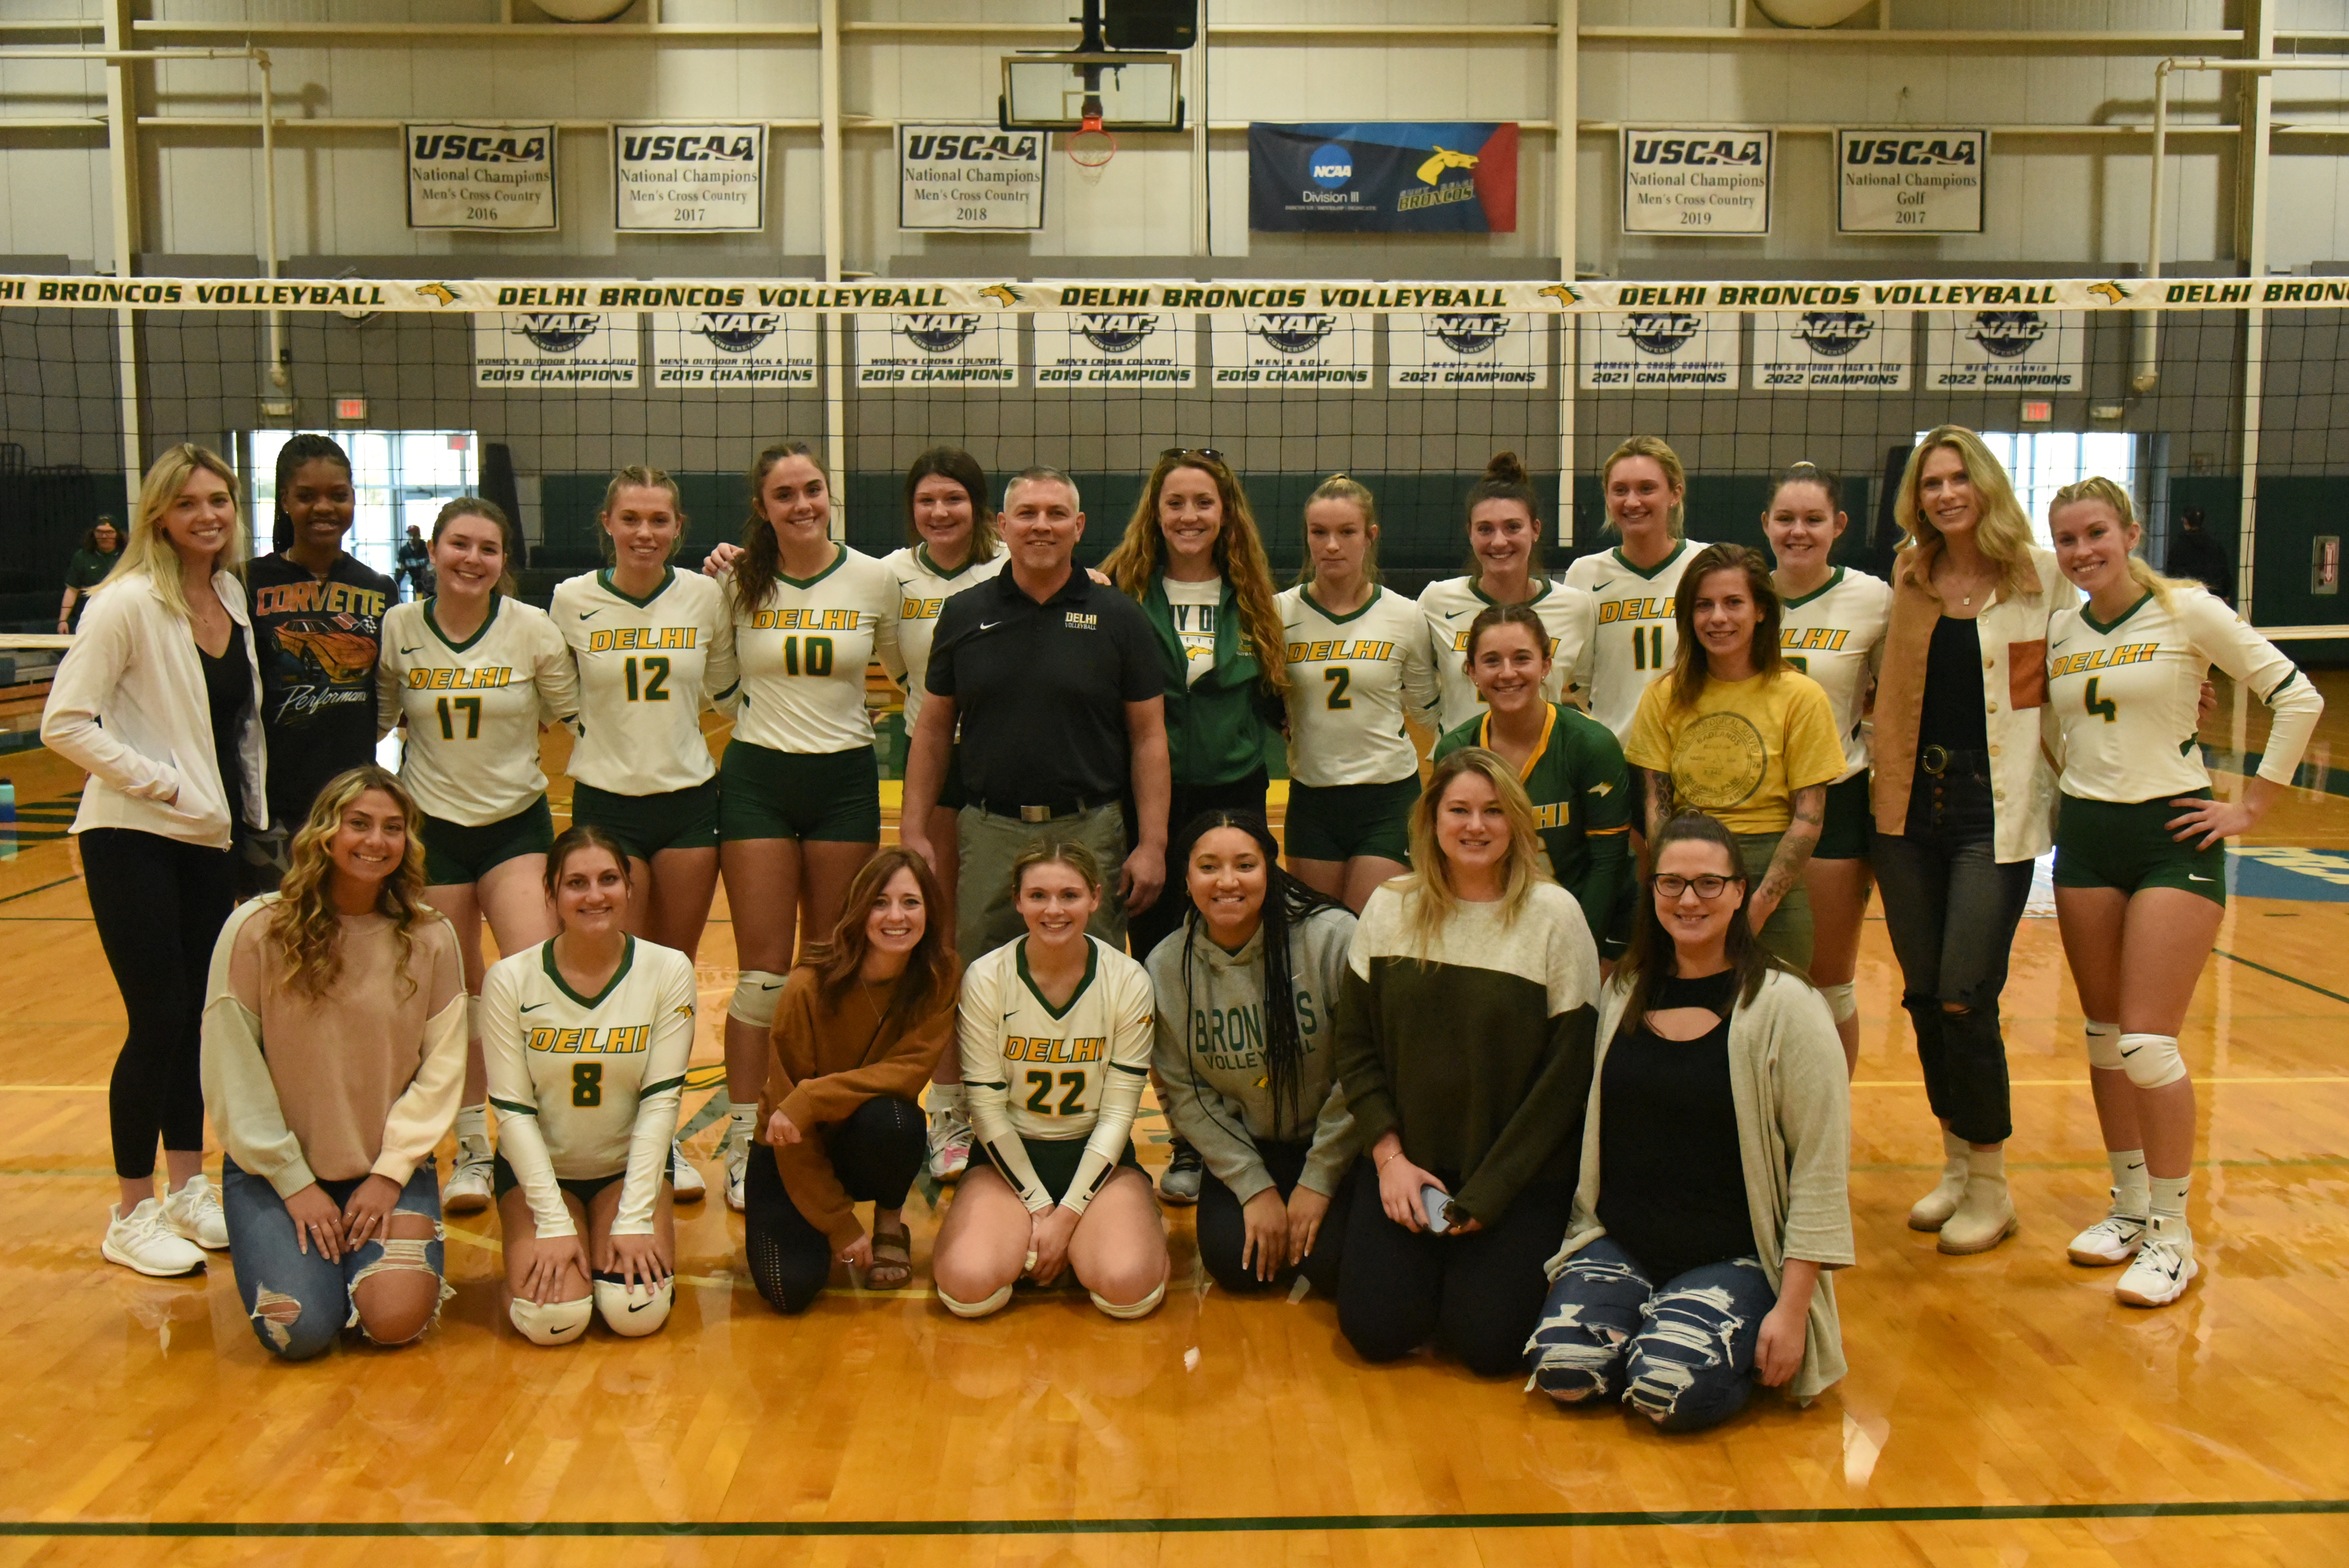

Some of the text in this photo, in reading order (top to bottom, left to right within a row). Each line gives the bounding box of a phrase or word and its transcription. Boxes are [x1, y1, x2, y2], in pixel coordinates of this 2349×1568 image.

[415, 135, 545, 163] USCAA
[624, 135, 754, 162] USCAA
[908, 135, 1037, 160] USCAA
[1633, 140, 1762, 166] USCAA
[1846, 140, 1975, 166] USCAA
[412, 168, 550, 187] National Champions
[620, 168, 758, 186] National Champions
[905, 168, 1040, 185] National Champions
[1313, 165, 1352, 178] NCAA
[1629, 172, 1765, 190] National Champions
[1846, 173, 1977, 190] National Champions
[423, 188, 542, 204] Men's Cross Country
[630, 189, 747, 205] Men's Cross Country
[914, 188, 1030, 204] Men's Cross Country
[1302, 190, 1359, 203] Division III
[1397, 185, 1474, 212] BRONCOS
[1637, 193, 1755, 208] Men's Cross Country
[1897, 191, 1926, 206] Golf
[466, 207, 498, 221] 2016
[674, 208, 705, 222] 2017
[956, 208, 988, 220] 2018
[1680, 212, 1712, 225] 2019
[1895, 211, 1926, 225] 2017
[38, 282, 183, 304] BRONCOS
[196, 284, 386, 305] VOLLEYBALL
[498, 286, 950, 307] DELHI BRONCOS VOLLEYBALL
[1059, 287, 1510, 308] DELHI BRONCOS VOLLEYBALL
[1617, 285, 2059, 306] DELHI BRONCOS VOLLEYBALL
[2165, 283, 2349, 303] DELHI BRON
[511, 313, 601, 334] NAC
[691, 313, 780, 334] NAC
[892, 314, 981, 334] NAC
[1070, 314, 1159, 335] NAC
[1248, 315, 1337, 335] NAC
[1426, 317, 1510, 336] NAC
[1617, 318, 1701, 337] NAC
[1791, 320, 1874, 339] NAC
[1965, 321, 2048, 340] NAC
[481, 370, 633, 381] 2019 CHAMPIONS
[660, 370, 813, 381] 2019 CHAMPIONS
[861, 369, 1014, 381] 2019 CHAMPIONS
[1039, 370, 1191, 381] 2019 CHAMPIONS
[1216, 370, 1368, 382] 2019 CHAMPIONS
[1399, 372, 1536, 382] 2021 CHAMPIONS
[1592, 373, 1727, 383] 2021 CHAMPIONS
[1764, 374, 1898, 384] 2022 CHAMPIONS
[1938, 374, 2072, 385] 2022 CHAMPIONS
[256, 580, 386, 617] CORVETTE
[751, 609, 860, 631] DELHI
[1065, 611, 1097, 625] DELHI
[1598, 597, 1677, 625] DELH
[1065, 622, 1097, 630] VOLLEYBALL
[589, 626, 698, 653] DELHI
[1632, 624, 1664, 671] 11
[1780, 628, 1850, 651] LHI
[782, 635, 834, 677] 10
[1286, 640, 1395, 664] DELHI
[2049, 643, 2160, 681] DELHI
[407, 667, 512, 690] DELHI
[623, 654, 671, 702] 12
[1323, 666, 1352, 711] 2
[2084, 674, 2117, 724] 4
[435, 696, 482, 740] 17
[1697, 731, 1741, 746] BADLANDS
[1195, 990, 1317, 1052] BRONS
[528, 1024, 650, 1054] DELHI
[1004, 1035, 1106, 1063] DELHI
[1204, 1039, 1316, 1070] VOLLEYL
[571, 1060, 604, 1108] 8
[1025, 1068, 1086, 1117] 22
